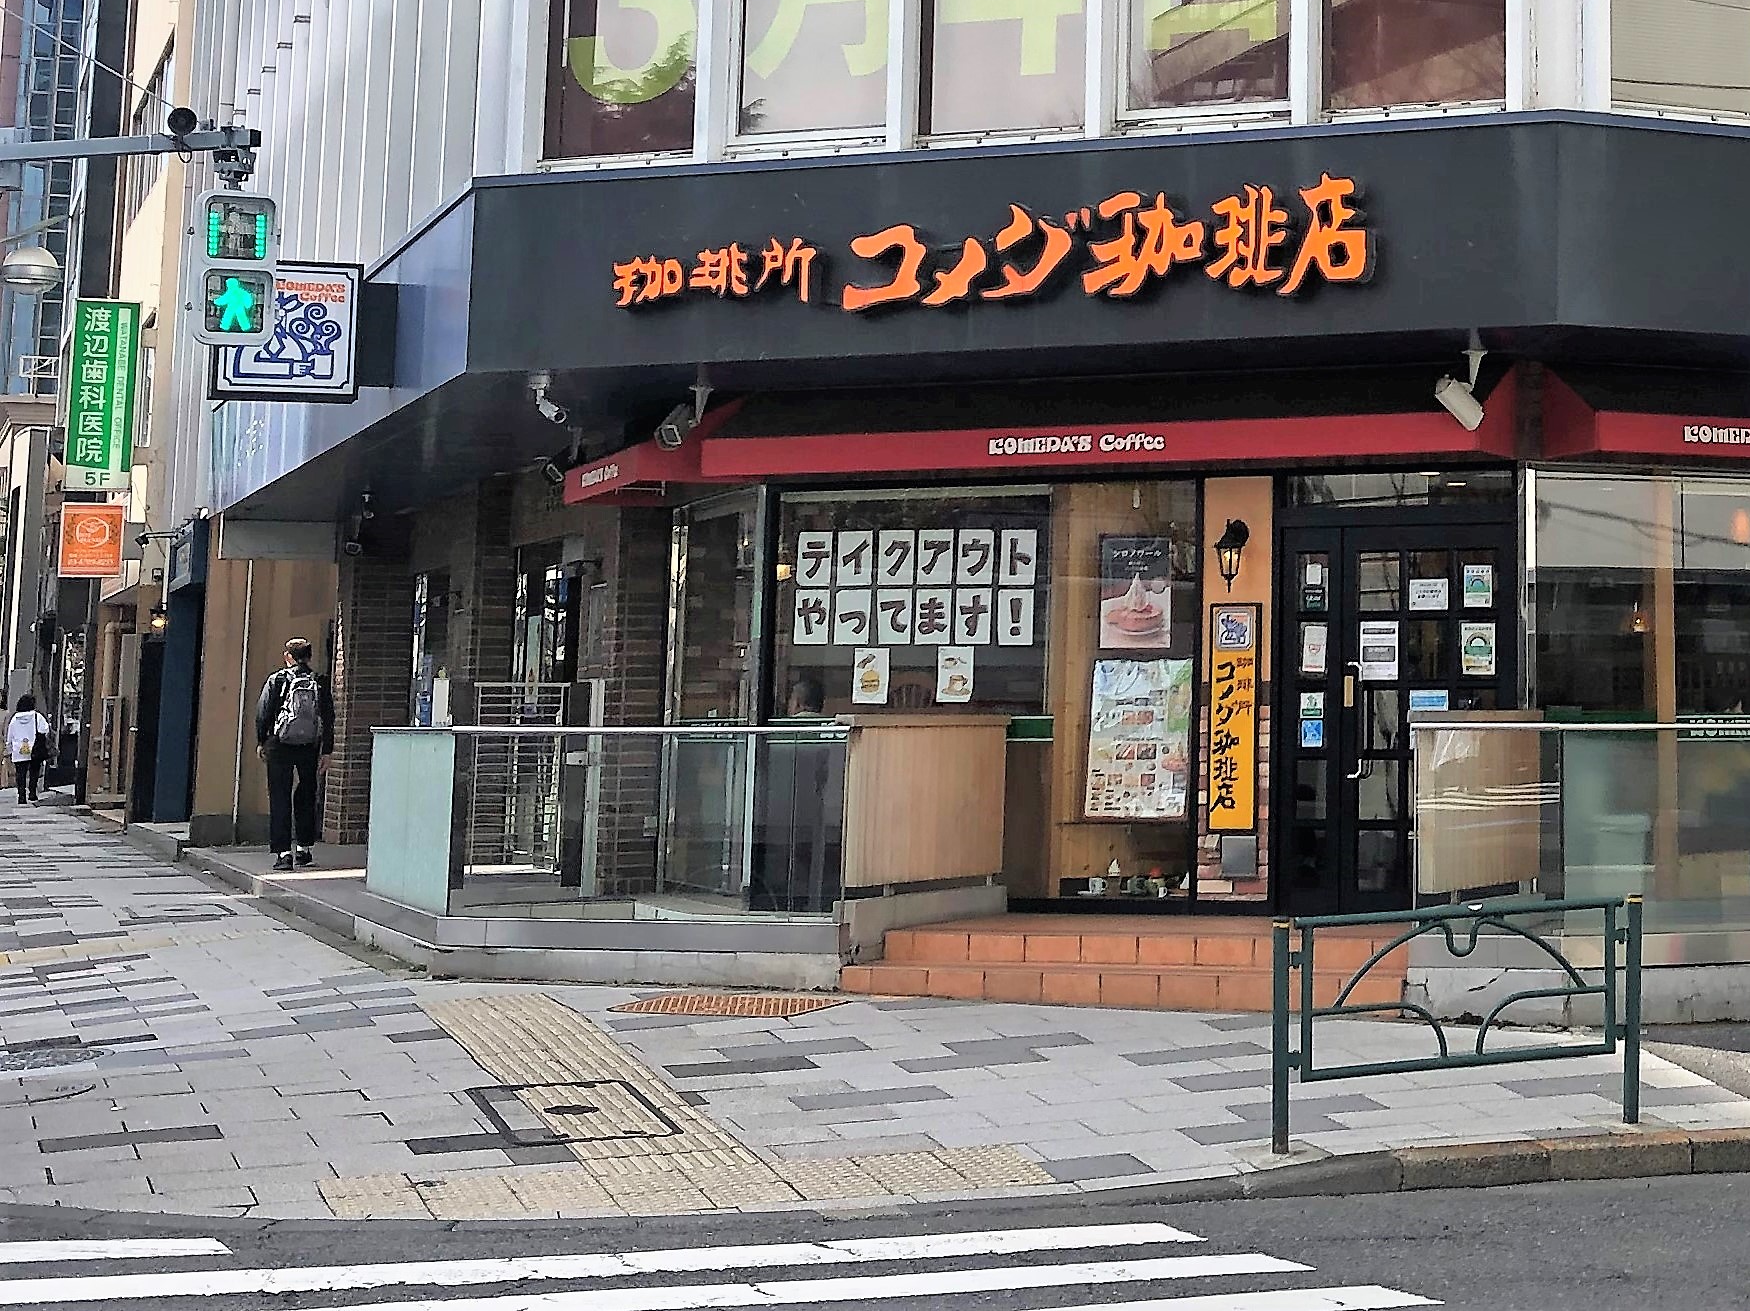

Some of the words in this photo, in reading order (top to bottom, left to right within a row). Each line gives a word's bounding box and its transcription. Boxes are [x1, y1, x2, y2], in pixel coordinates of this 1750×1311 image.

[614, 237, 814, 306] 珈琲所
[843, 173, 1368, 313] コメダ珈琲店
[76, 307, 111, 463] 渡辺歯科医院
[988, 435, 1093, 455] KOMEDA'S
[1099, 432, 1166, 452] Coffee
[84, 471, 111, 486] 5F
[801, 537, 1032, 579] テイクアウト
[797, 594, 1023, 637] やってます！
